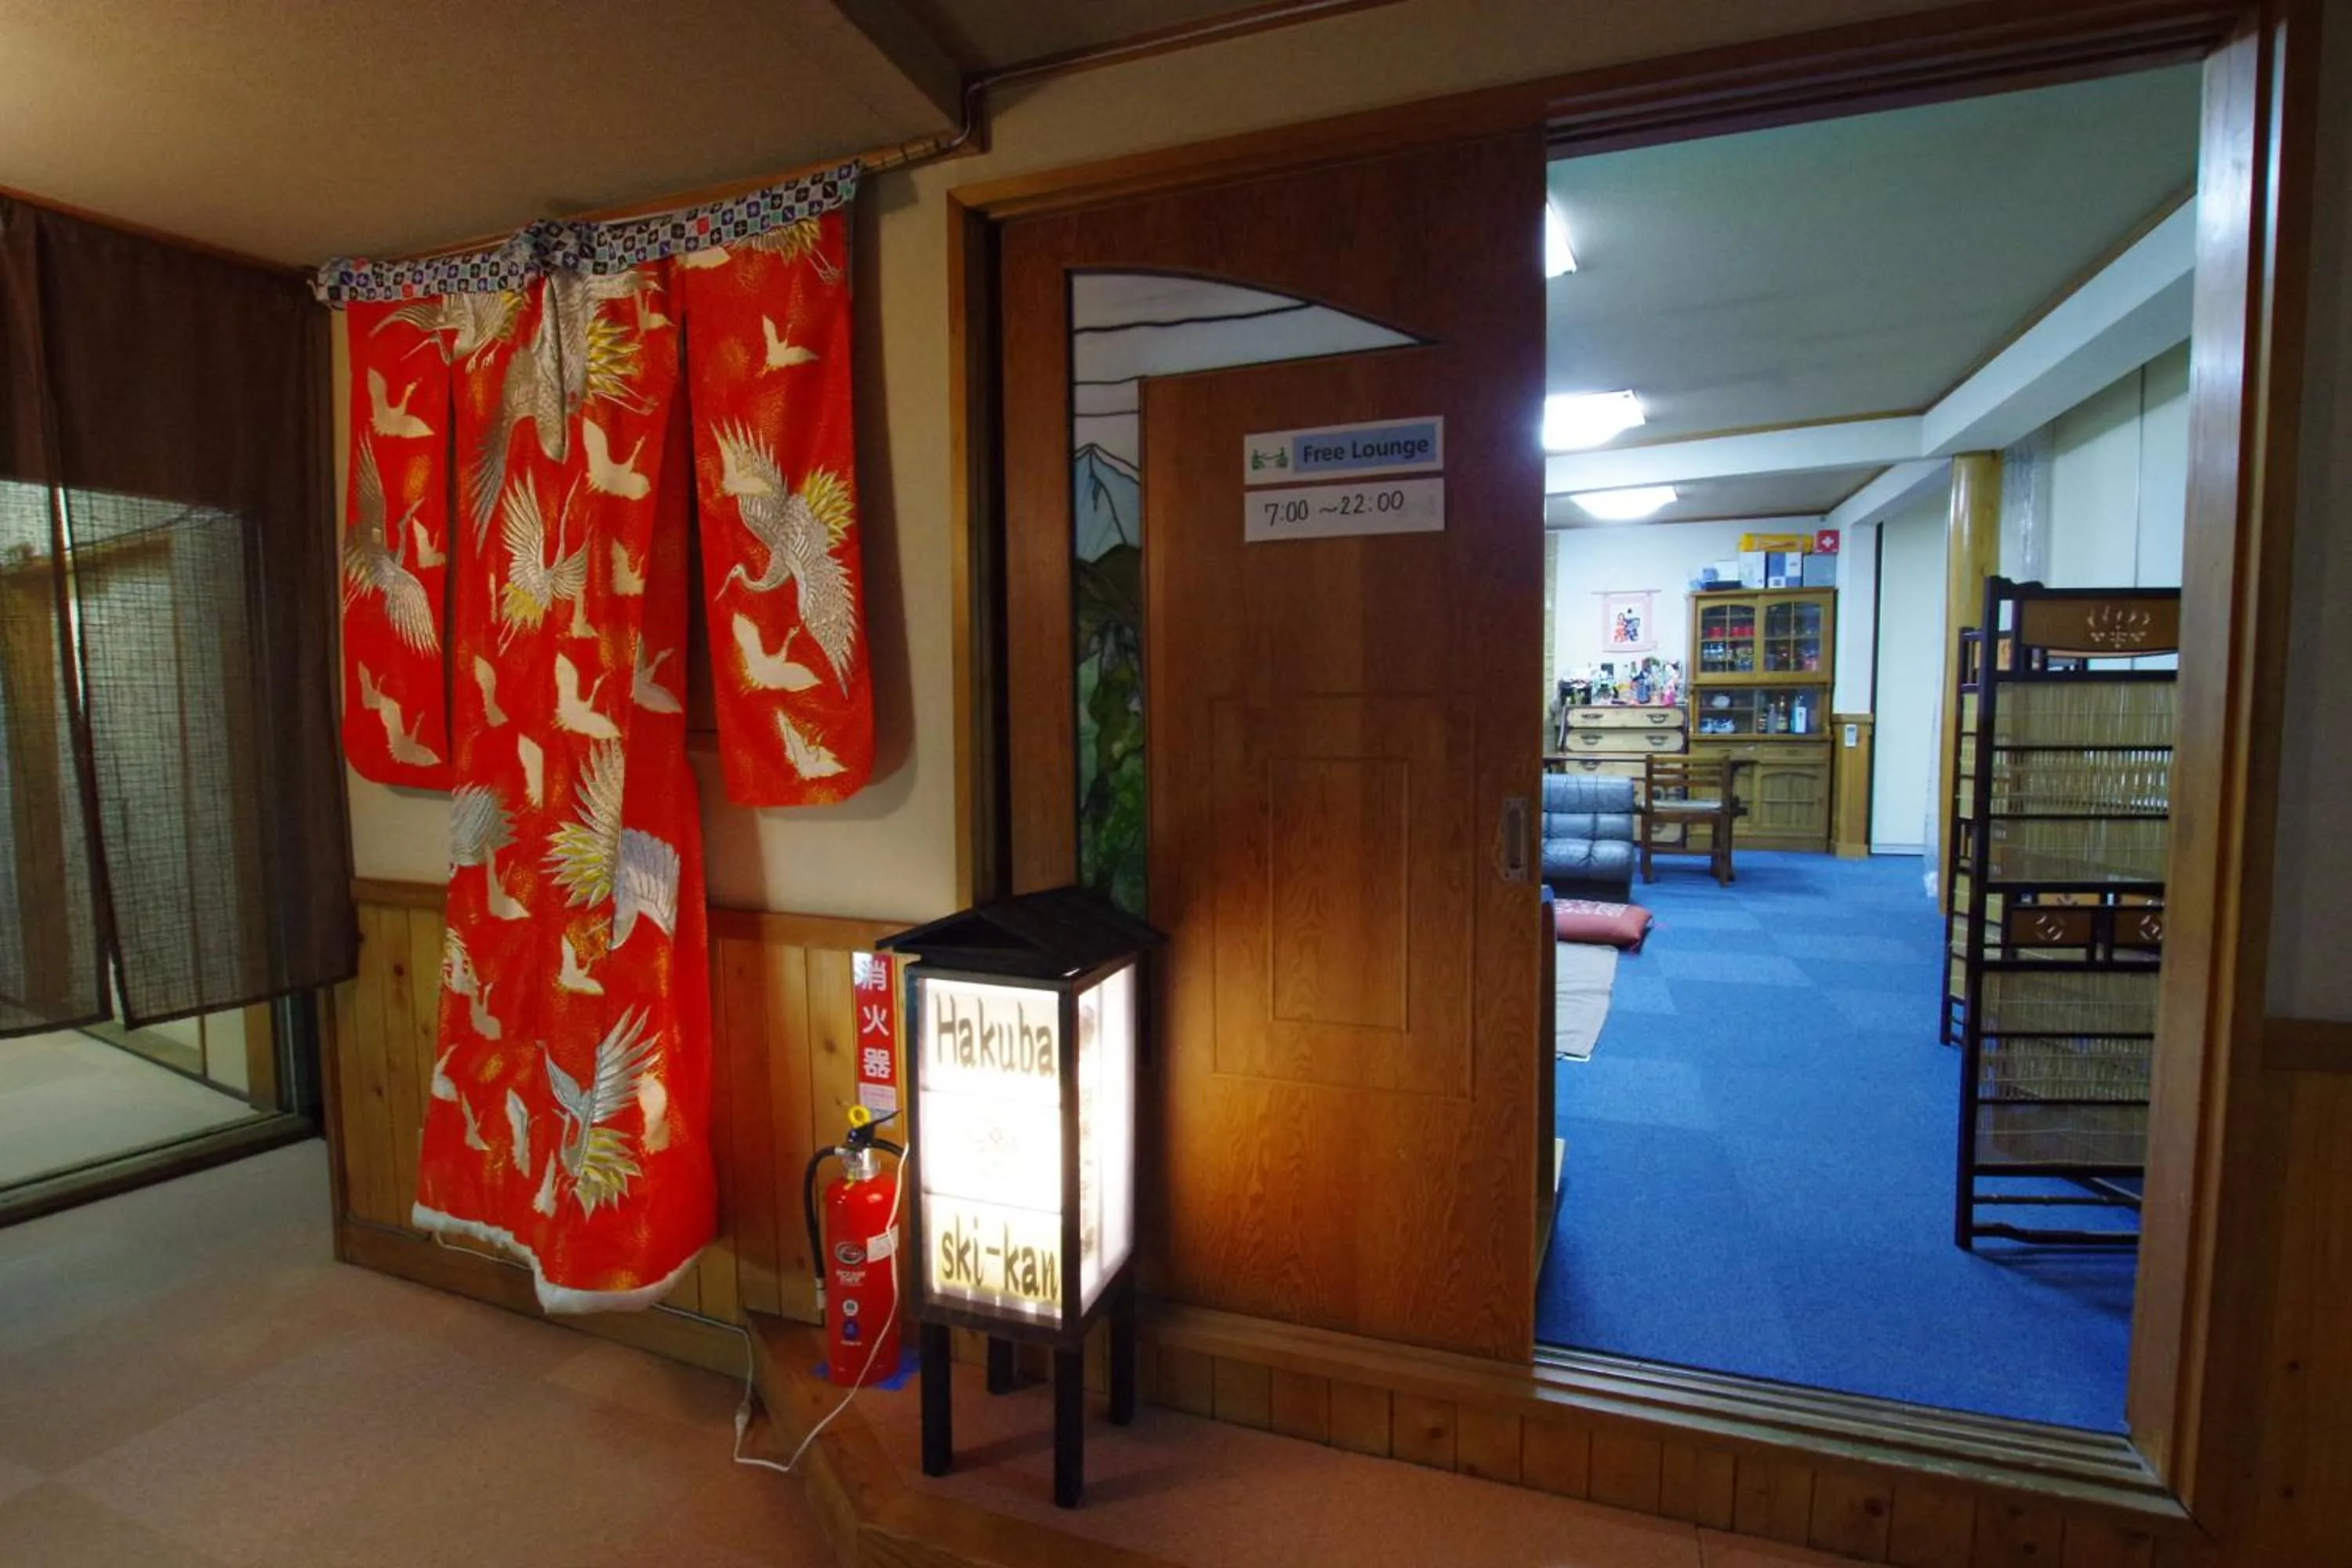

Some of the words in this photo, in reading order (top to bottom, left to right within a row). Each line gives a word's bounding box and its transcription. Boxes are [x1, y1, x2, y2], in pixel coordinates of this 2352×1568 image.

[1303, 445, 1345, 464] Free
[1352, 438, 1428, 459] Lounge
[1265, 499, 1308, 527] 7:00
[861, 960, 891, 1079] 消火器
[935, 993, 1055, 1078] Hakuba
[942, 1214, 1058, 1301] ski-kan
